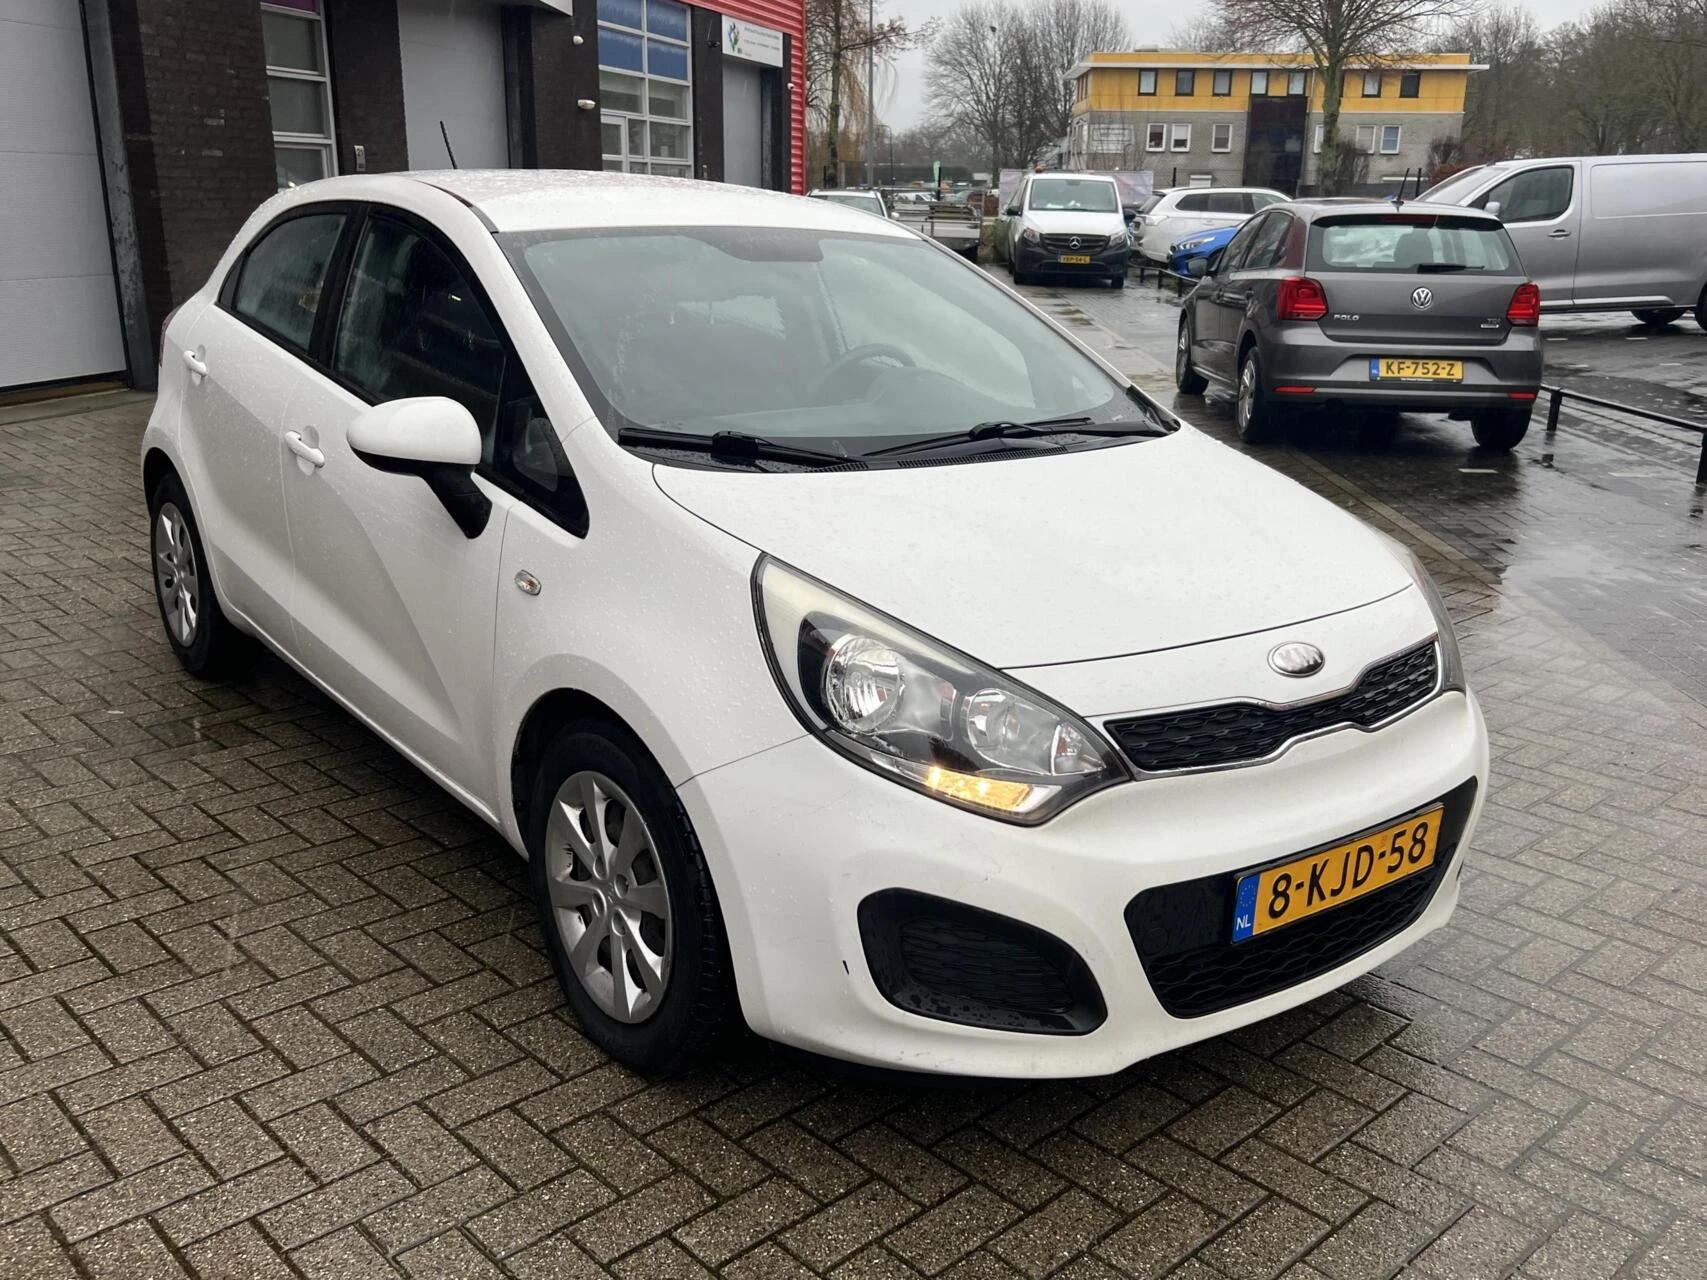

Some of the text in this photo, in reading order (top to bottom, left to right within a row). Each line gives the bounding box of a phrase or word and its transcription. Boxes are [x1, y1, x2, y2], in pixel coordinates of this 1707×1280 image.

[1385, 360, 1456, 377] KF-752-Z
[1268, 821, 1429, 920] 8-KJD-58
[1236, 914, 1252, 931] NL
